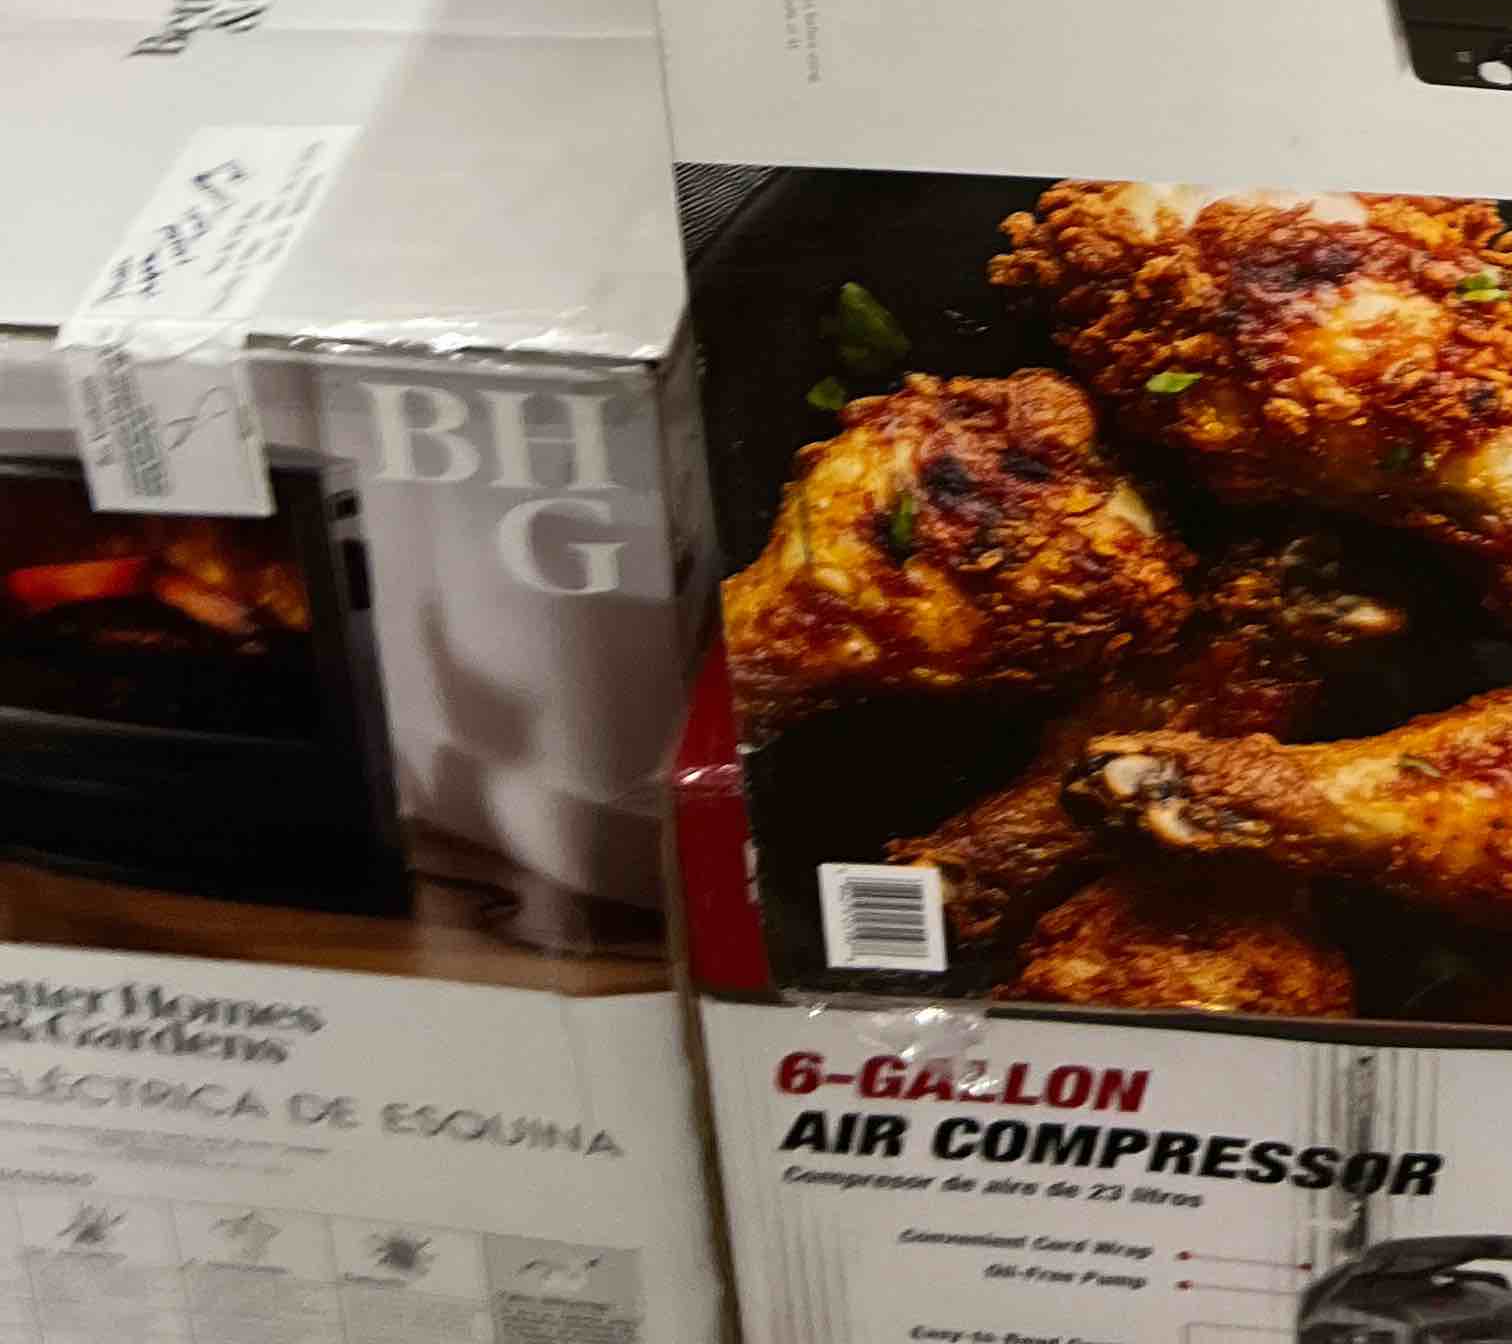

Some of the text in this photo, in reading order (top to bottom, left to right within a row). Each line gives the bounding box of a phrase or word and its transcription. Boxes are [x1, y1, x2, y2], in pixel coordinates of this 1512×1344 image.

[496, 497, 630, 597] G
[285, 1092, 362, 1130] DE
[380, 1101, 627, 1159] ESQUINA
[778, 1109, 1444, 1198] AIR COMPRESSOR
[940, 1173, 978, 1194] de
[1045, 1179, 1081, 1201] de
[1087, 1182, 1125, 1204] 23
